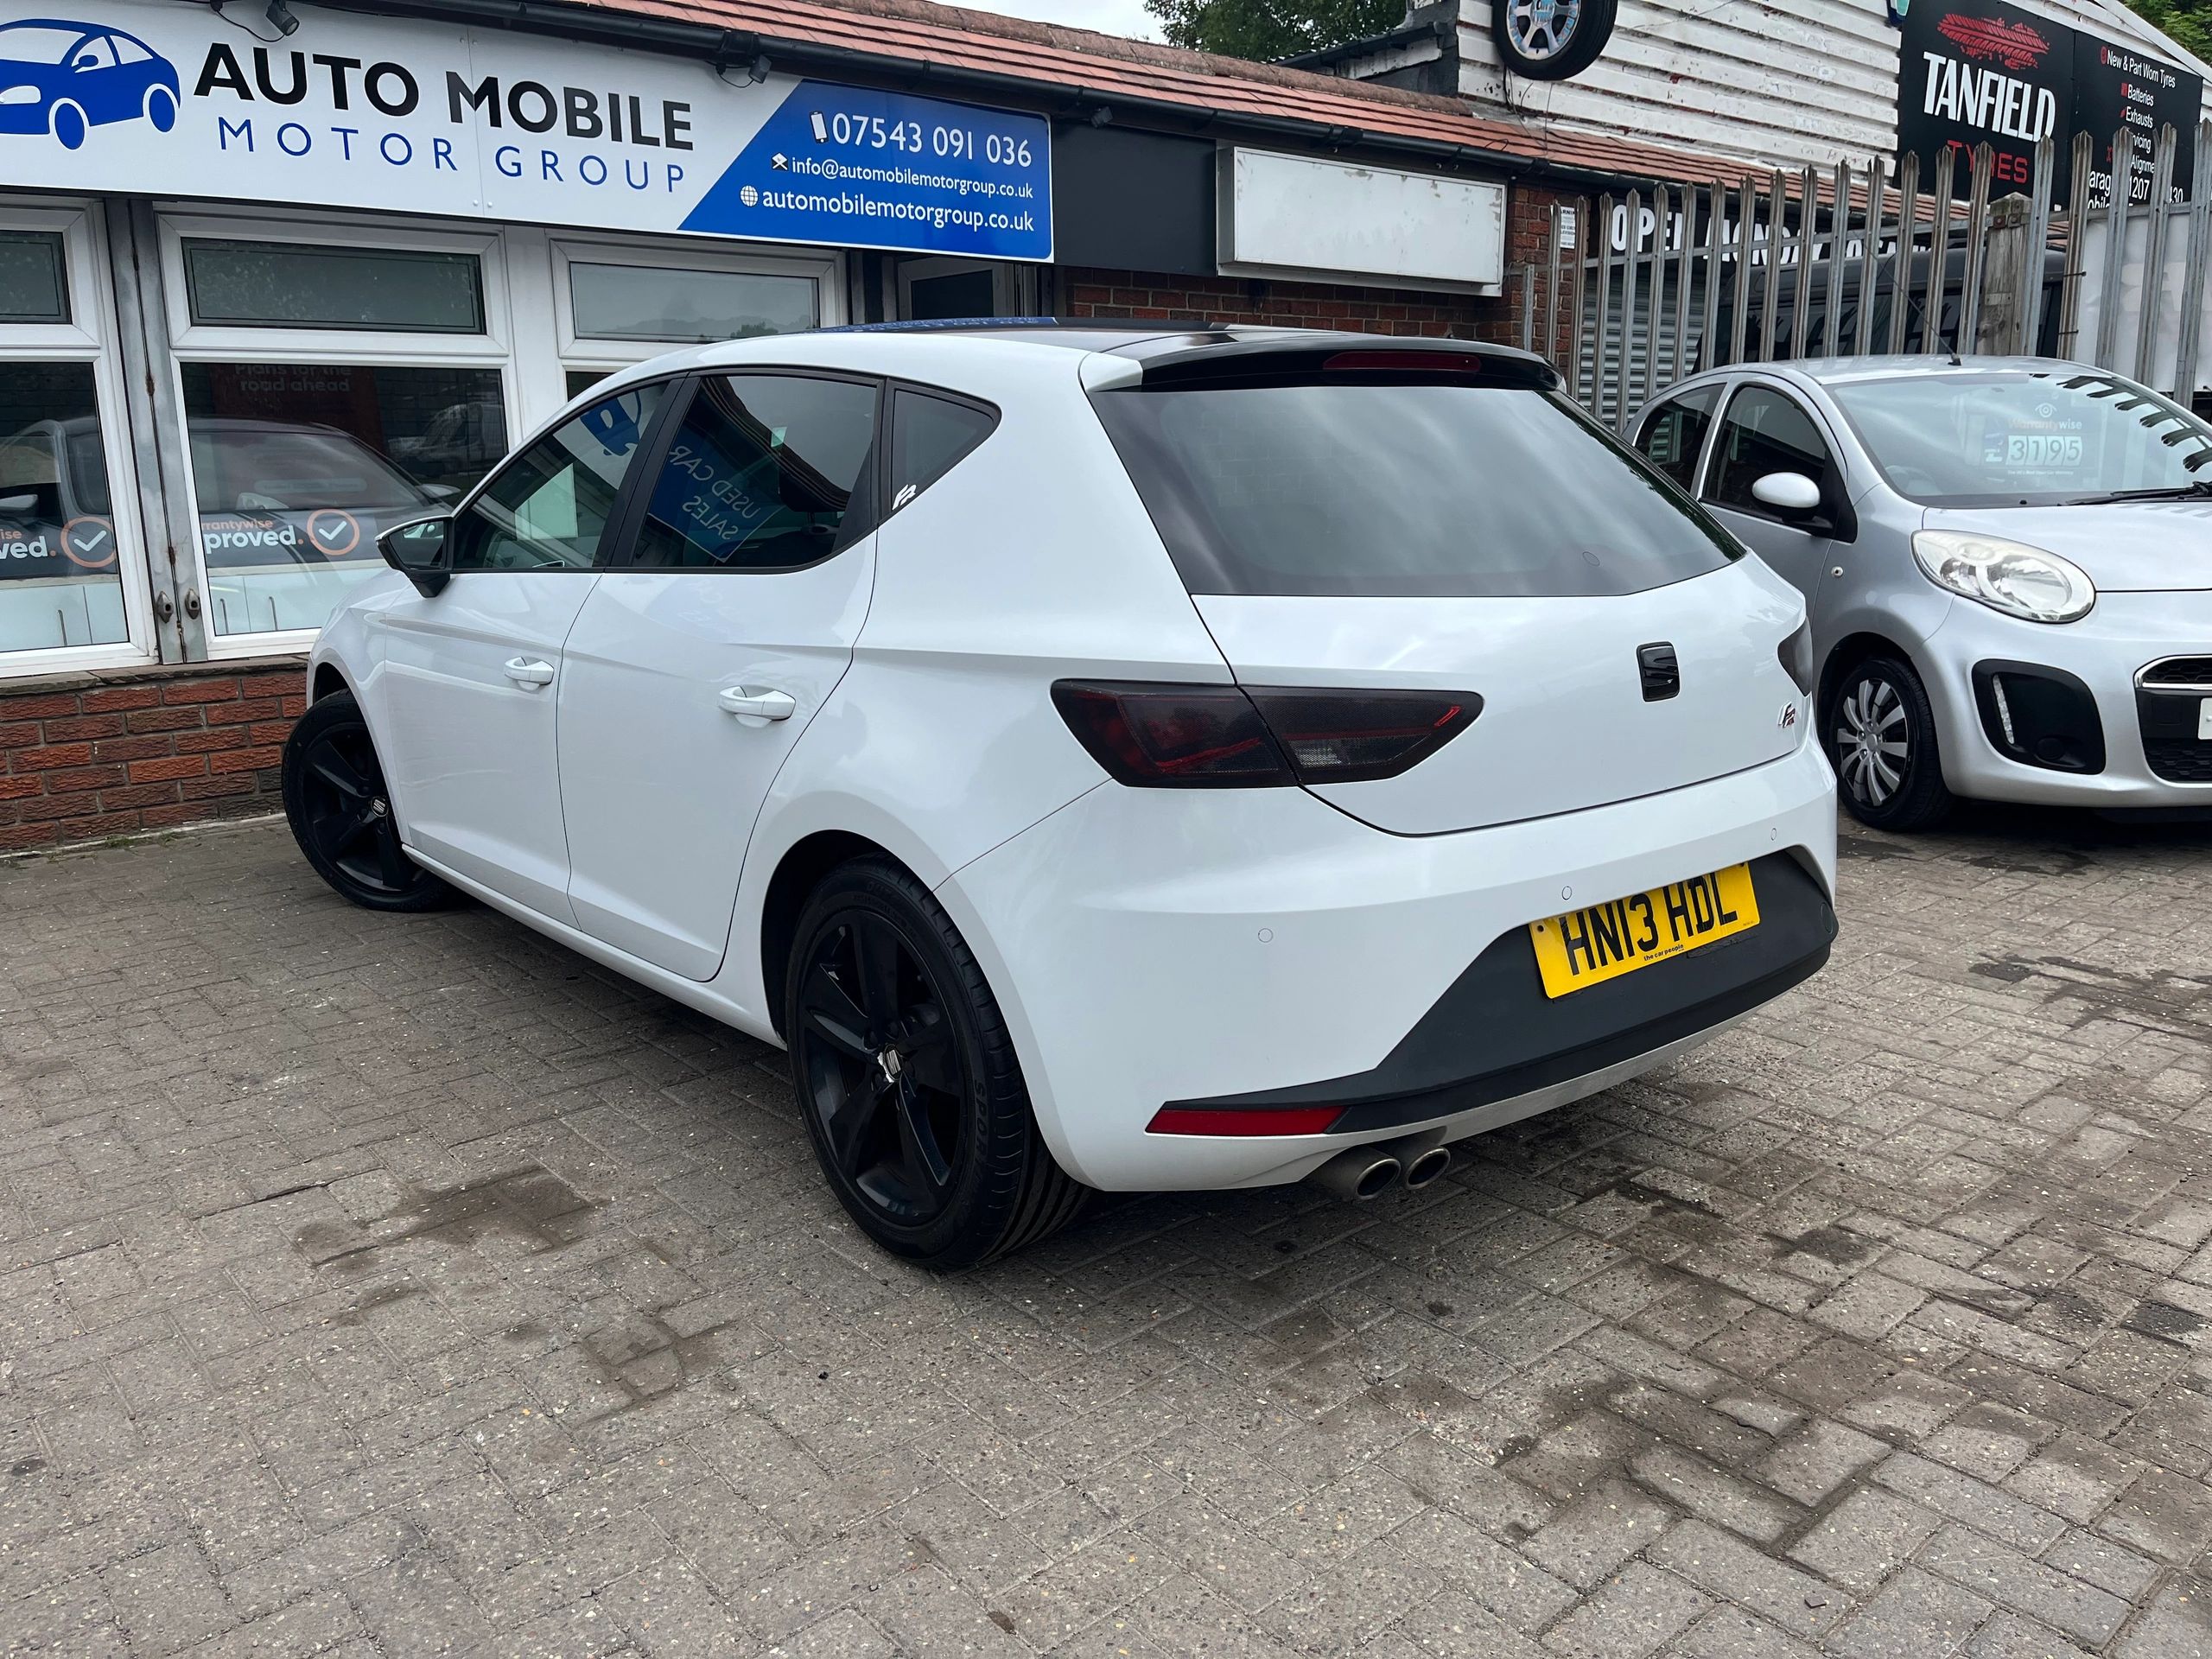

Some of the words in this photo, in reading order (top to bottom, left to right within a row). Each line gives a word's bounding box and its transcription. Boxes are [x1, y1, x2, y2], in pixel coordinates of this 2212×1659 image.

[2107, 49, 2122, 69] New
[2122, 55, 2128, 71] &
[2129, 58, 2142, 76] Part
[2143, 63, 2158, 82] Worn
[2160, 69, 2176, 88] Tyres
[194, 42, 419, 117] AUTO
[446, 71, 693, 151] MOBILE
[1923, 51, 2056, 143] TANFIELD
[2127, 83, 2153, 107] Batteries
[2126, 105, 2153, 128] Exhausts
[832, 112, 922, 153] 07543
[932, 126, 972, 160] 091
[986, 135, 1032, 168] 036
[2133, 132, 2152, 154] rvicing
[218, 117, 457, 171] MOTOR
[495, 146, 683, 193] GROUP
[2130, 154, 2154, 174] Alignme
[791, 157, 1033, 199] info@automobilemotorgroup.co.uk
[2089, 171, 2112, 197] arag
[2128, 175, 2150, 200] 1207
[762, 191, 1034, 232] automobilemotorgroup.co.uk
[240, 378, 285, 391] road
[290, 378, 350, 391] ahead
[0, 529, 22, 539] ise
[201, 519, 273, 531] rrantywise
[204, 525, 304, 554] proved.
[1560, 893, 1659, 976] HN13
[1662, 872, 1738, 942] HDL
